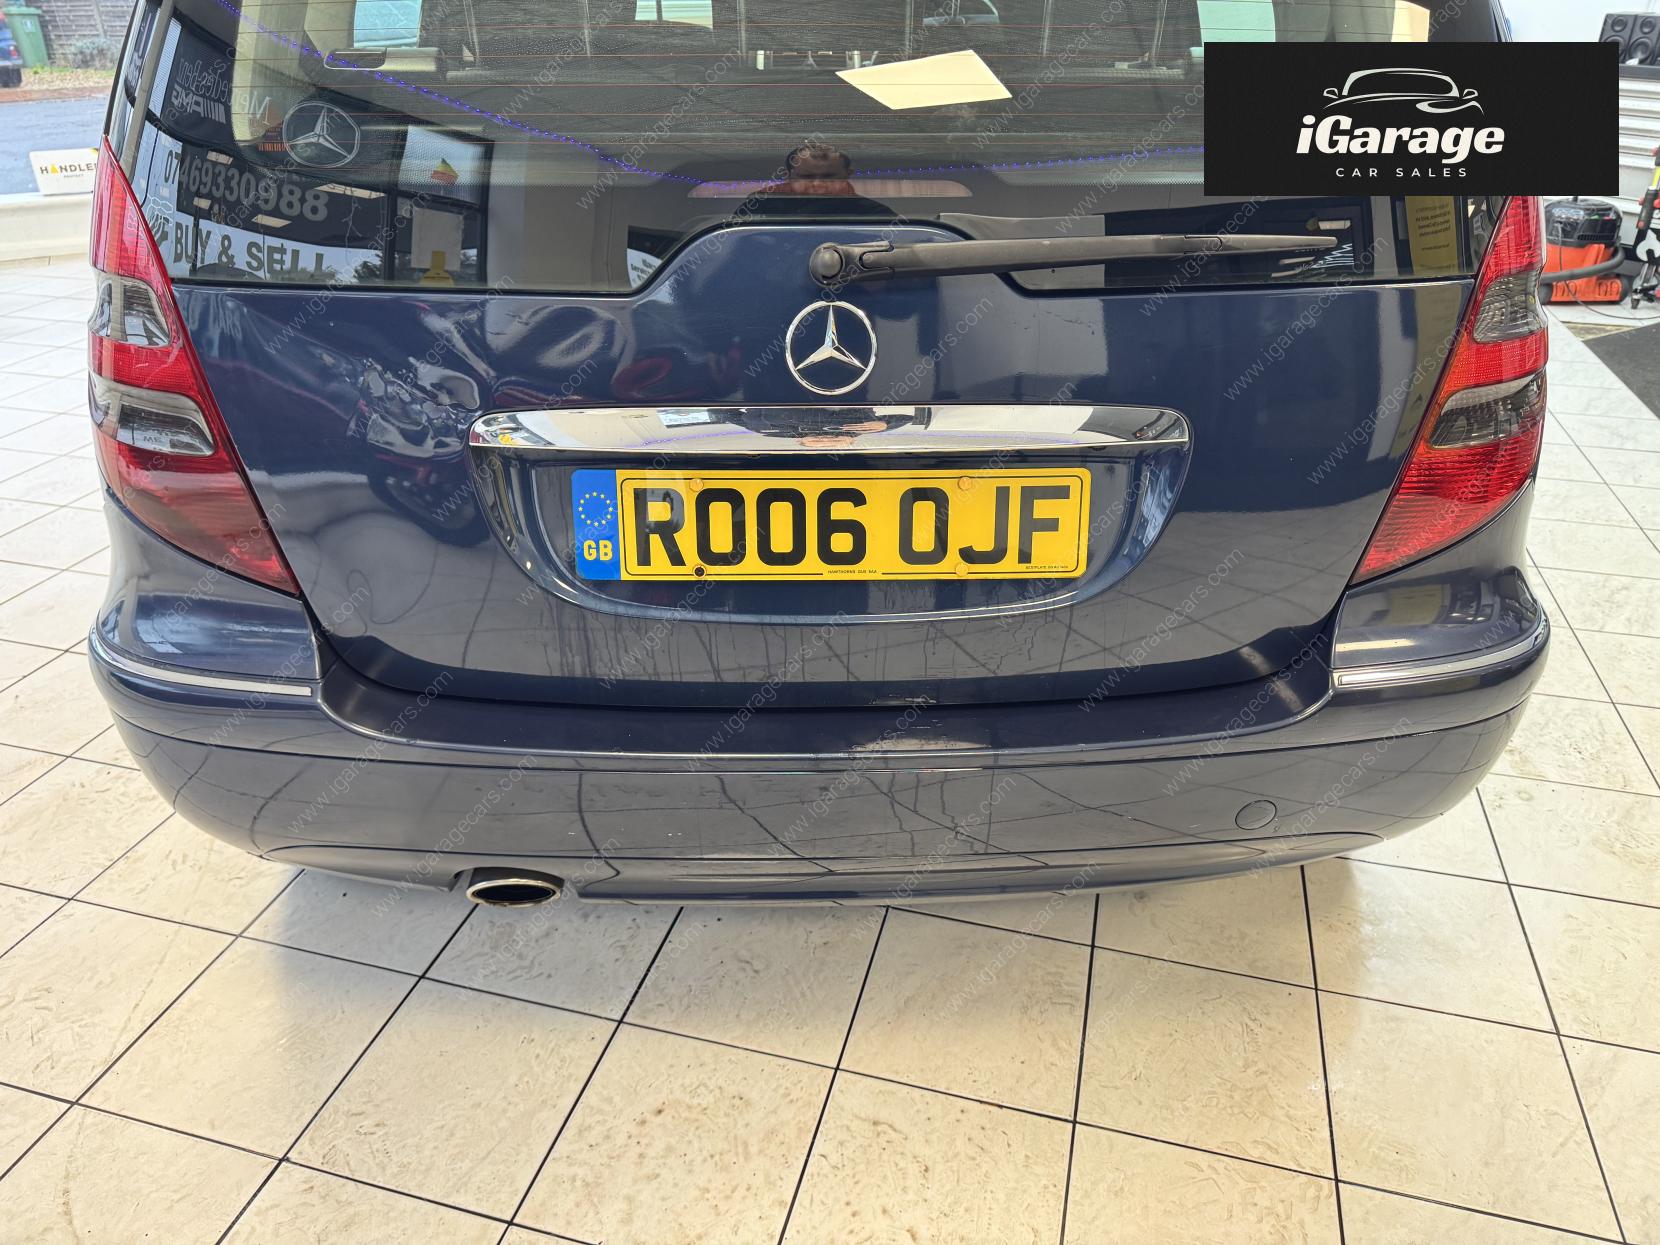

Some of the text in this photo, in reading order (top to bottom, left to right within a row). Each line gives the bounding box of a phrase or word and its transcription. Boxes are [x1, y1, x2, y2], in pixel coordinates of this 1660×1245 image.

[173, 221, 211, 265] BUY
[217, 234, 236, 269] &
[583, 539, 613, 561] GB
